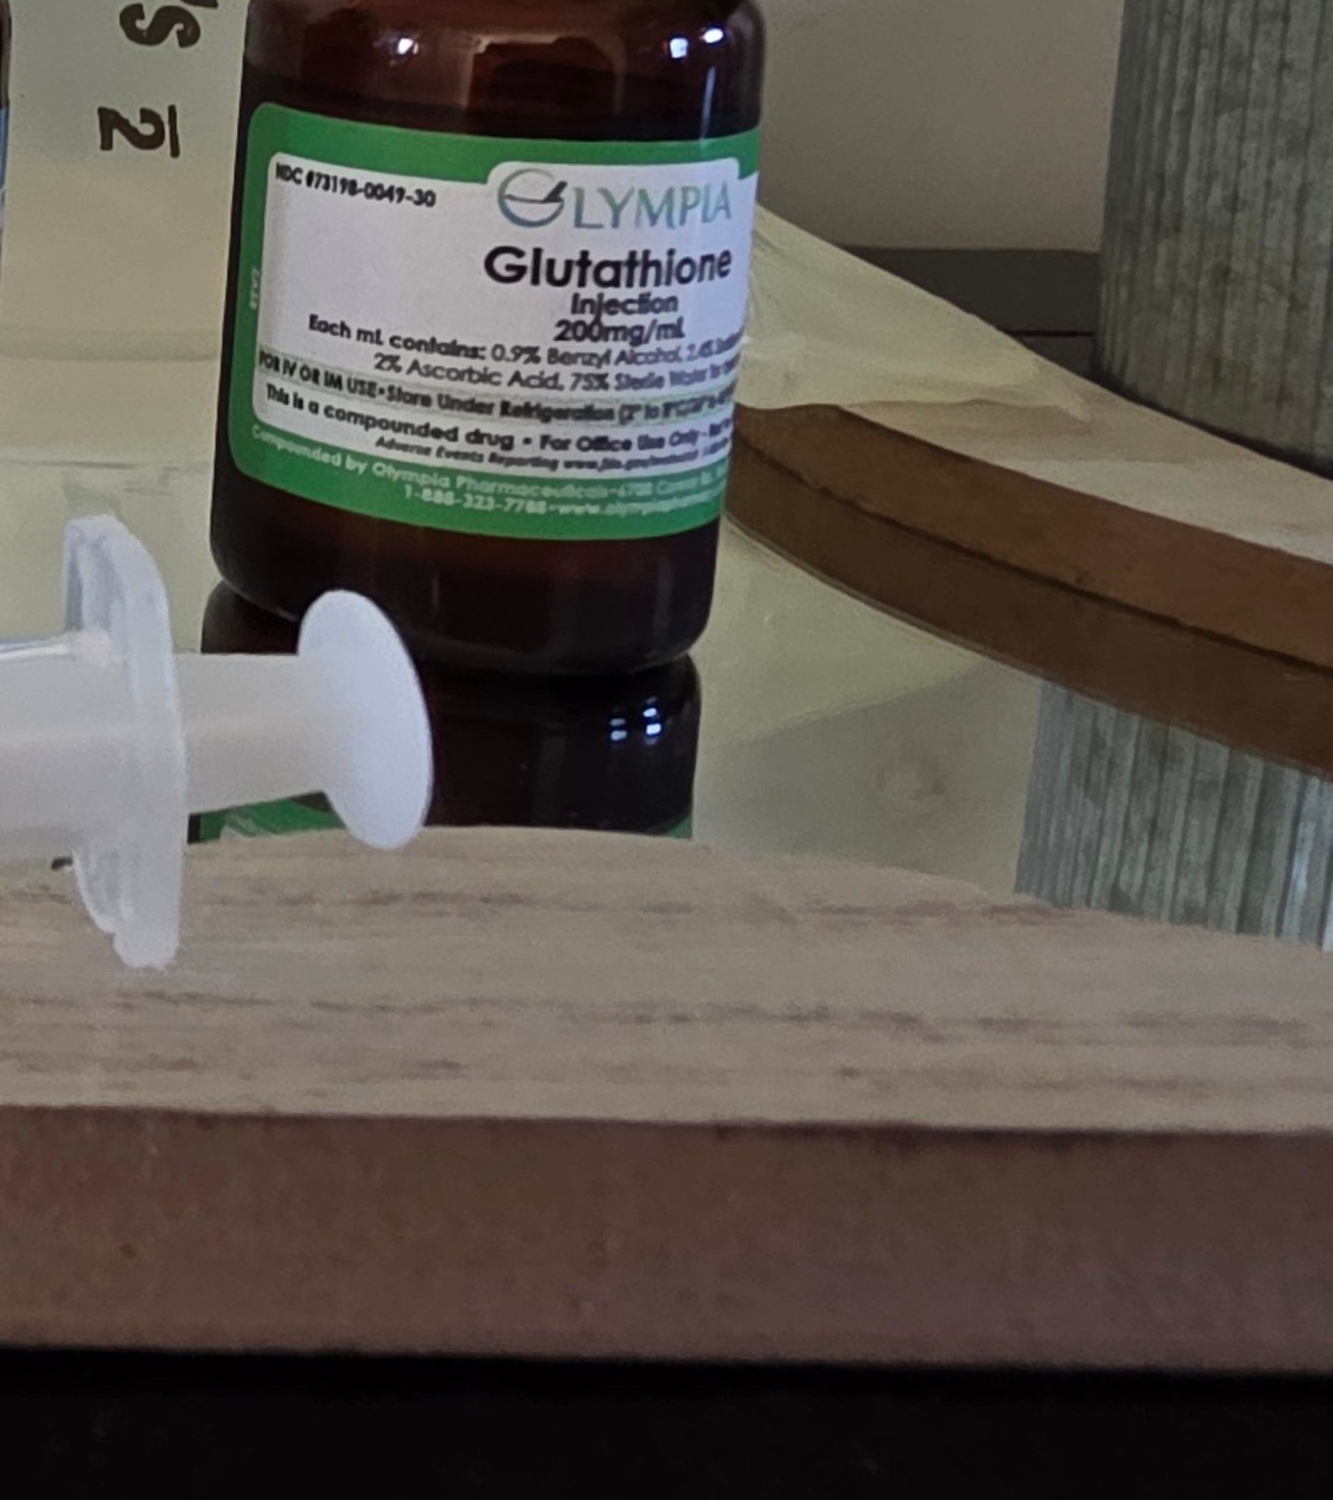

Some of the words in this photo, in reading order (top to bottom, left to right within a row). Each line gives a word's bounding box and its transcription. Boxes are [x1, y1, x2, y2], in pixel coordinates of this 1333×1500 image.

[97, 105, 167, 152] 2
[275, 161, 303, 185] NDC
[483, 244, 733, 289] Glutathione
[570, 291, 680, 320] Injection
[307, 313, 352, 339] Each
[388, 333, 487, 361] contains:
[491, 342, 542, 365] 0.9%
[546, 347, 613, 369] Benzyl
[258, 350, 280, 372] FOR
[299, 364, 321, 385] OR
[437, 393, 496, 417] Under
[499, 400, 616, 423] Refrigeration
[373, 351, 404, 374] 2%
[405, 359, 503, 387] Ascorbic
[569, 371, 611, 391] 75%
[266, 382, 291, 406] This
[323, 403, 459, 443] compounded
[464, 427, 515, 447] drug
[539, 434, 572, 451] For
[575, 433, 633, 452] Office
[251, 422, 343, 468] Compounded
[344, 454, 368, 476] by
[371, 461, 451, 489] Olympia
[374, 435, 433, 457] Adverse
